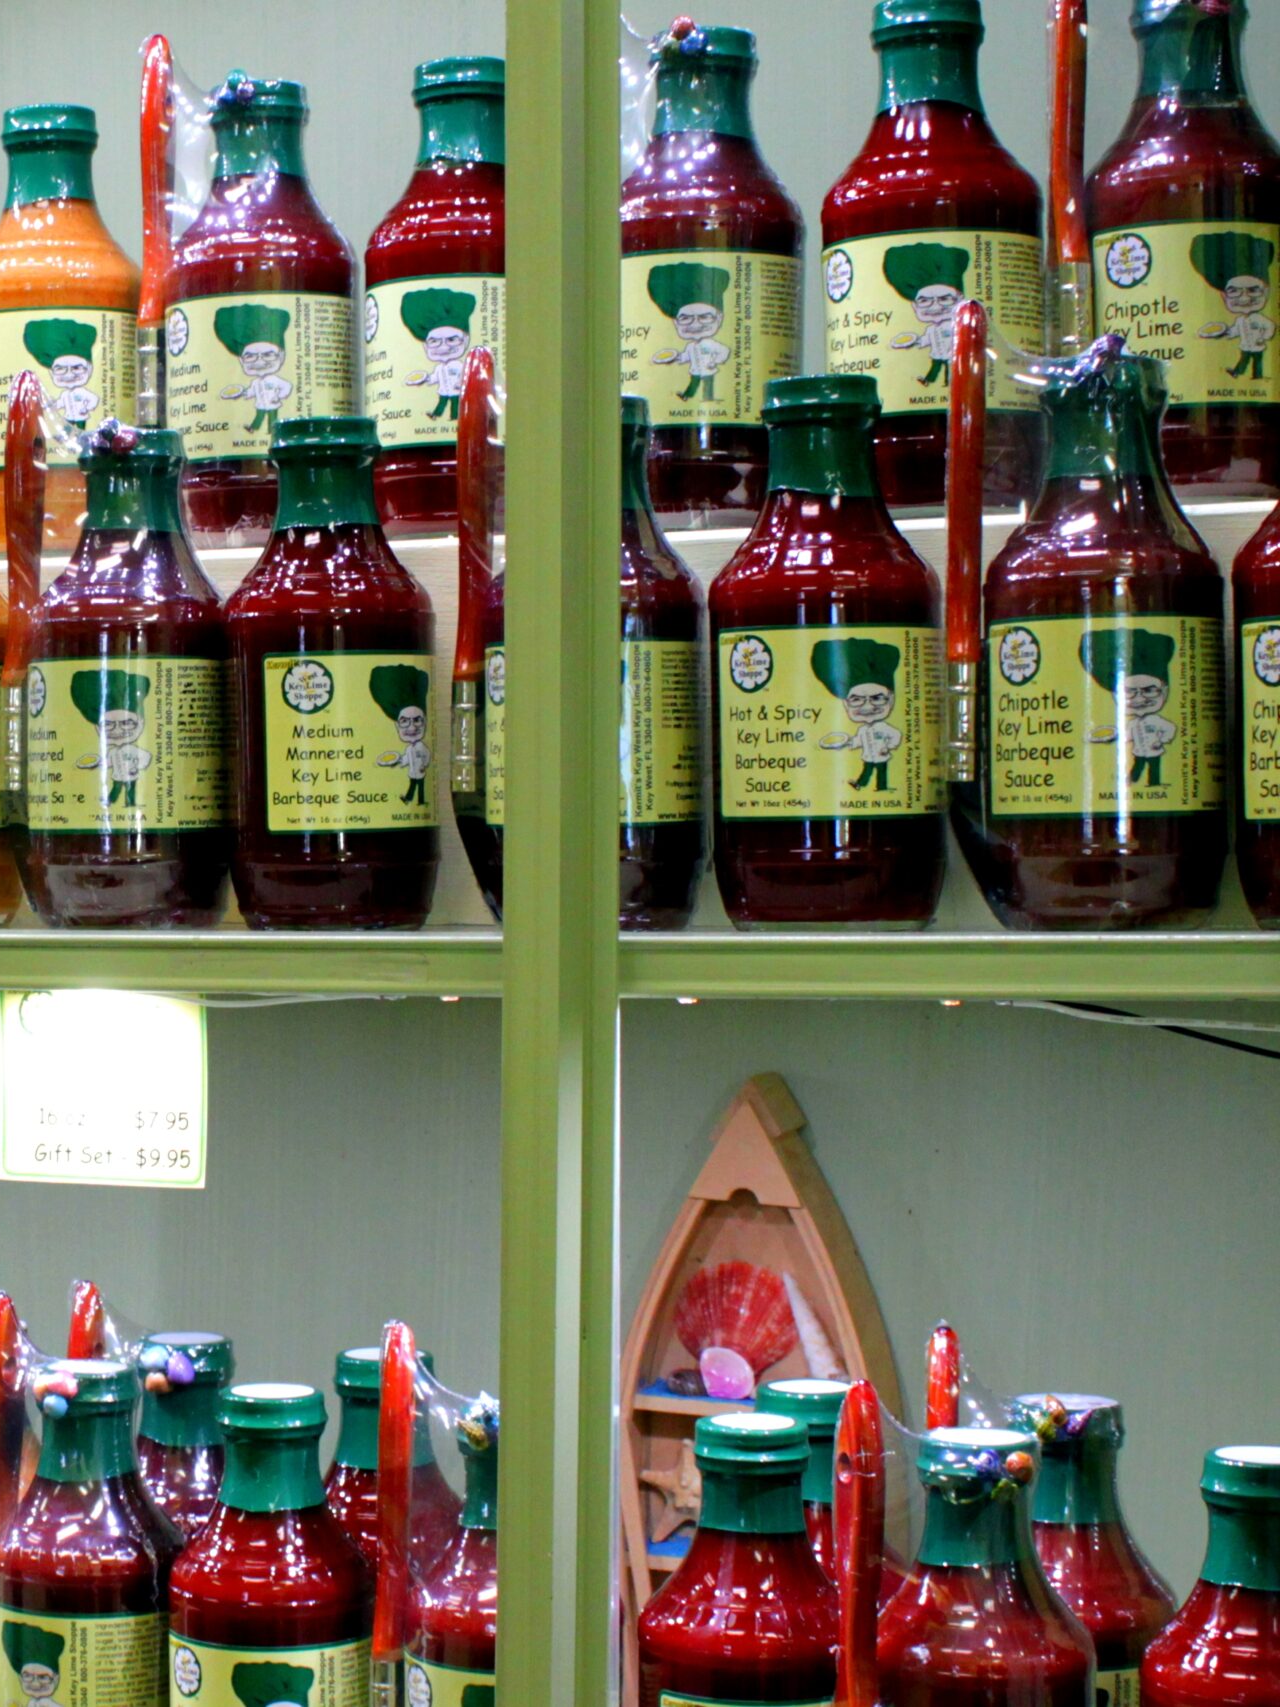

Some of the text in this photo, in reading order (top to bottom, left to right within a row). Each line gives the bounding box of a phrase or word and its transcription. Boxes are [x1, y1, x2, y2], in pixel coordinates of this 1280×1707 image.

[1105, 297, 1179, 321] Chipotle
[854, 311, 892, 329] Spicy
[1137, 321, 1183, 338] Lime
[849, 334, 878, 348] Lime
[372, 390, 391, 401] Lime
[910, 396, 937, 404] MADE
[1207, 389, 1235, 397] MADE
[183, 402, 206, 415] Lime
[382, 409, 412, 421] Sauce
[707, 409, 727, 417] USA
[196, 421, 229, 433] Sauce
[999, 690, 1069, 713] Chipotle
[730, 704, 822, 723] Hot & Spicy
[292, 725, 353, 739] Medium
[998, 716, 1072, 738] Key Lime
[737, 728, 805, 747] Key Lime
[1252, 726, 1278, 748] Key
[286, 746, 363, 761] Mannered
[996, 744, 1074, 766] Barbeque
[736, 754, 807, 773] Barbeque
[40, 772, 62, 783] Lime
[292, 768, 362, 785] Key Lime
[1004, 770, 1054, 788] Sauce
[745, 778, 791, 793] Sauce
[273, 791, 388, 807] Barbeque Sauce
[1133, 792, 1168, 800] IN USA
[840, 800, 902, 809] MADE IN USA
[35, 1143, 190, 1168] Gift Set $9.95
